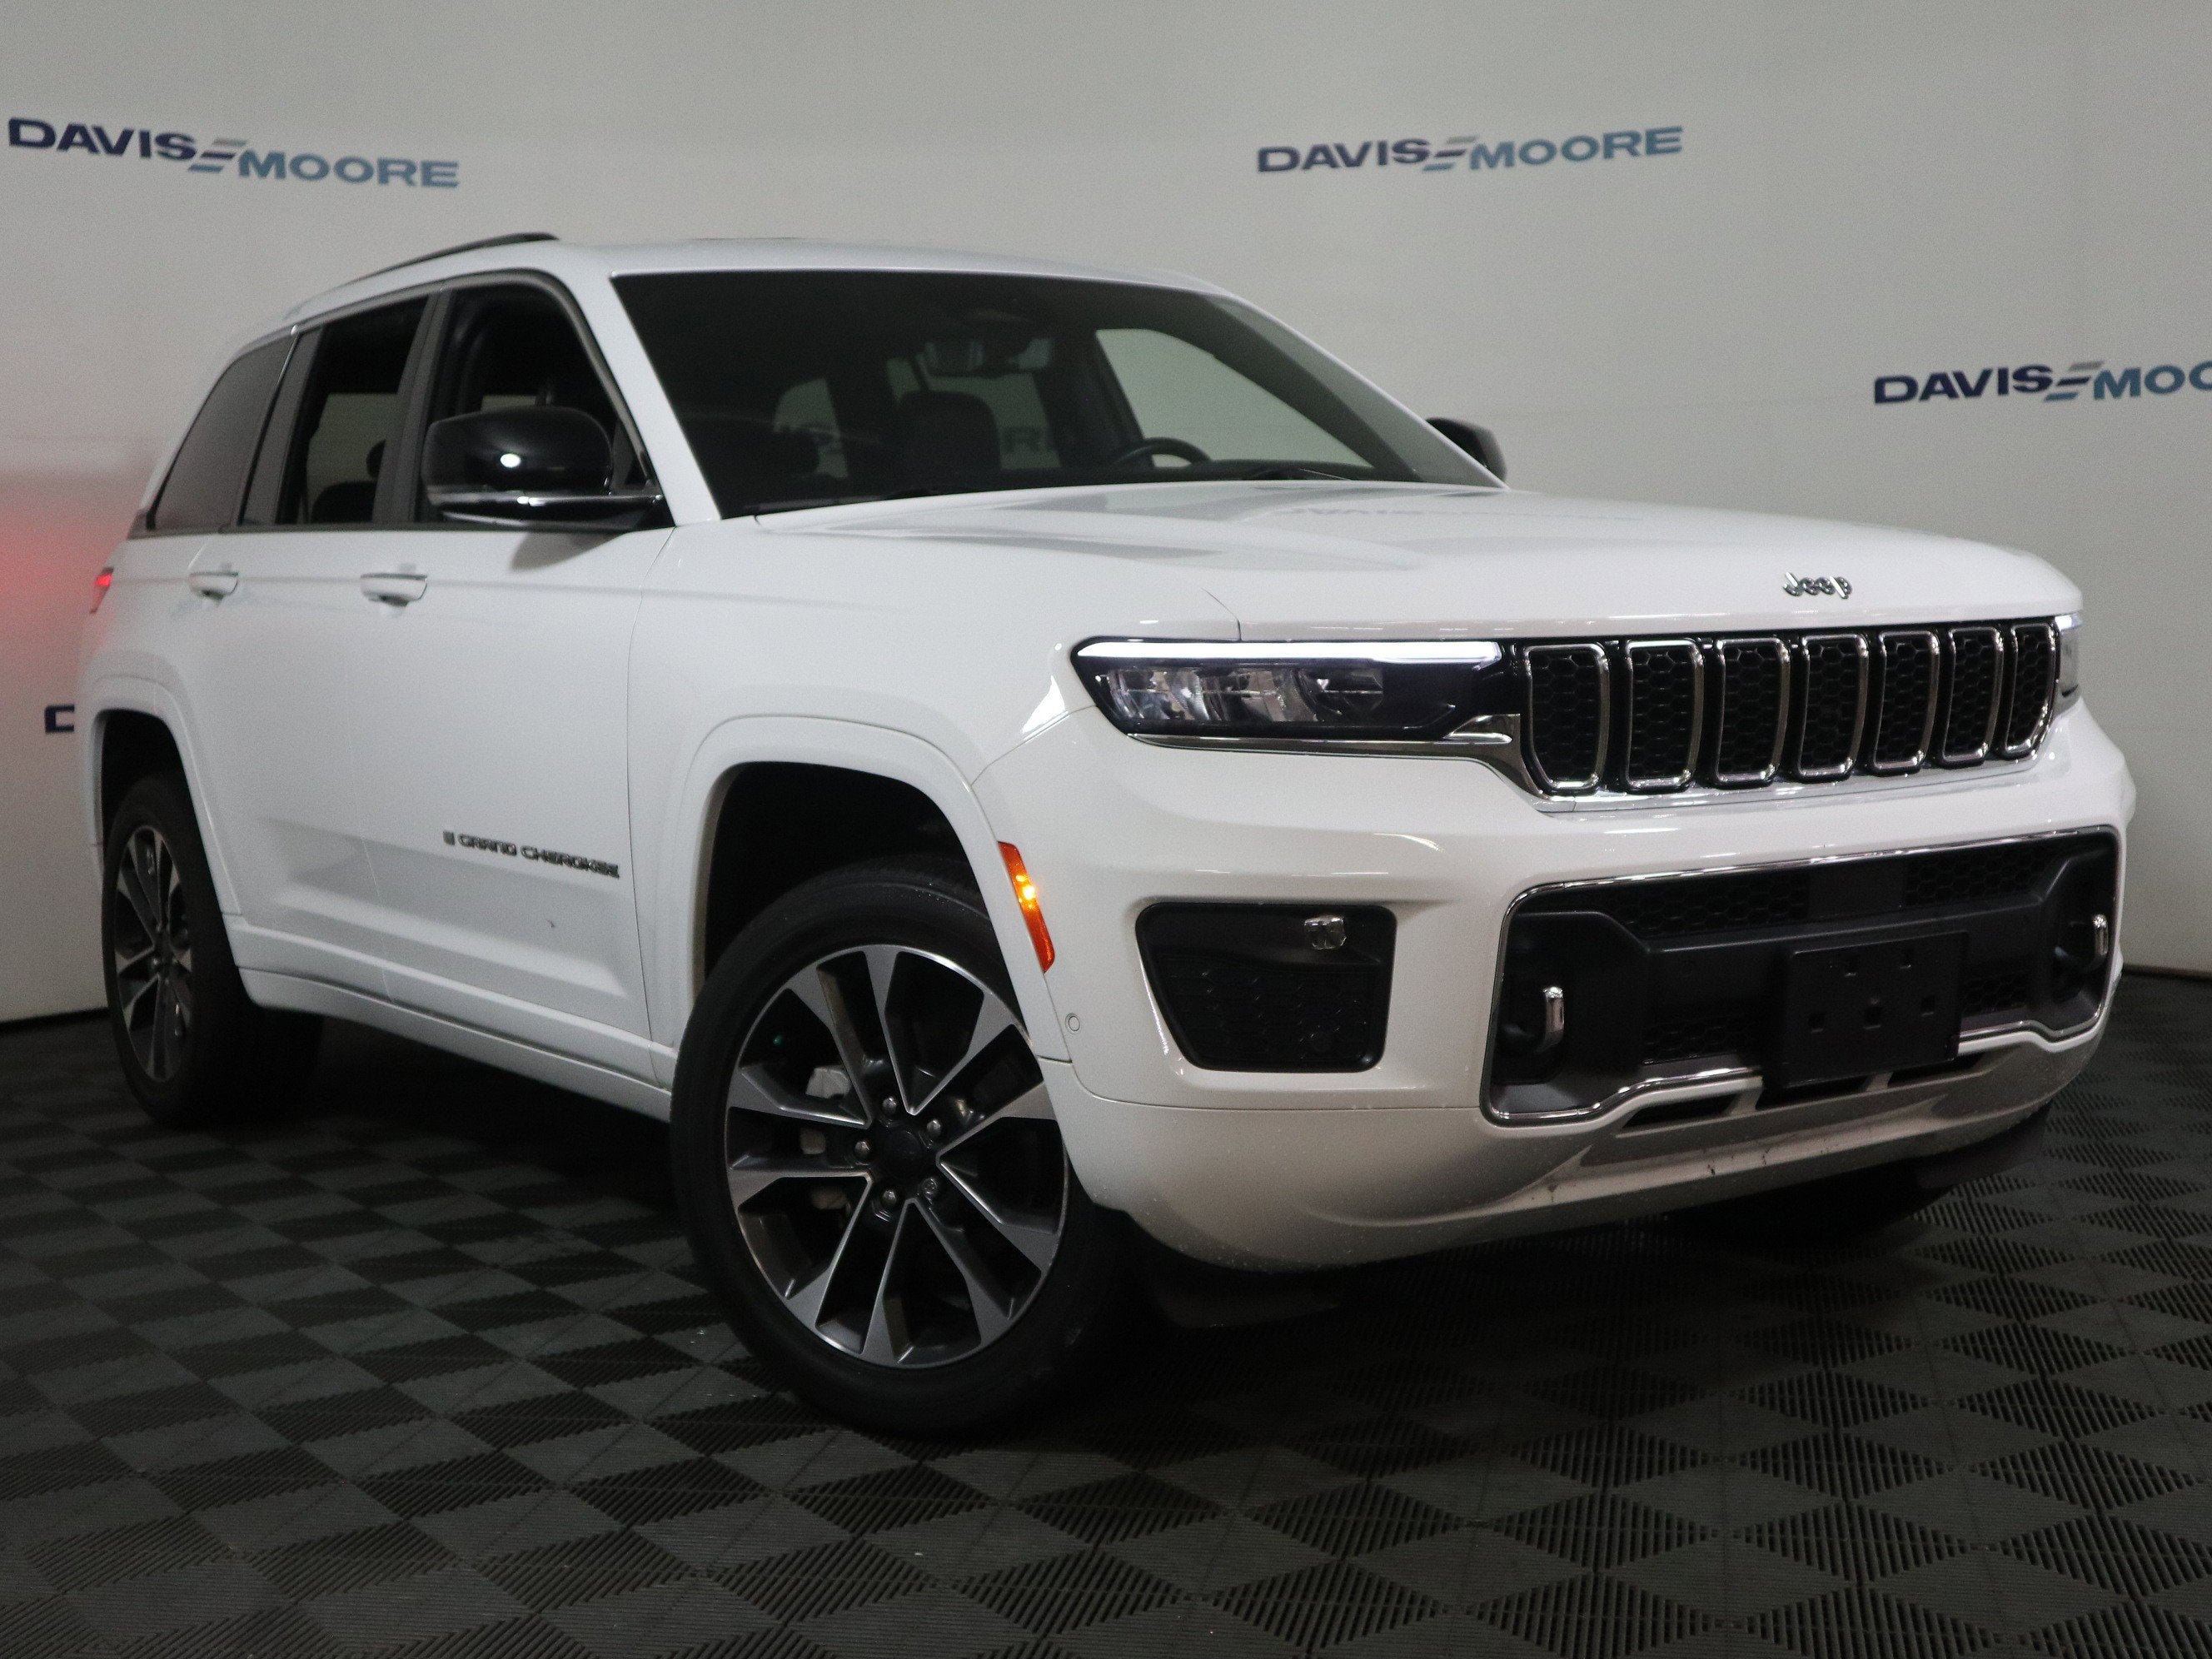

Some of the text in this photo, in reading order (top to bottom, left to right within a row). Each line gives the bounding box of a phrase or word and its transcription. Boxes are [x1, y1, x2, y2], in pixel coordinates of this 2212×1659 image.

[7, 117, 460, 188] DAVIS MOORE
[1257, 126, 1684, 173] DAVIS MOORE
[1874, 364, 2055, 405] DAVIS
[1783, 571, 1853, 600] Jeep
[457, 834, 620, 879] GRAND CHEROKEE
